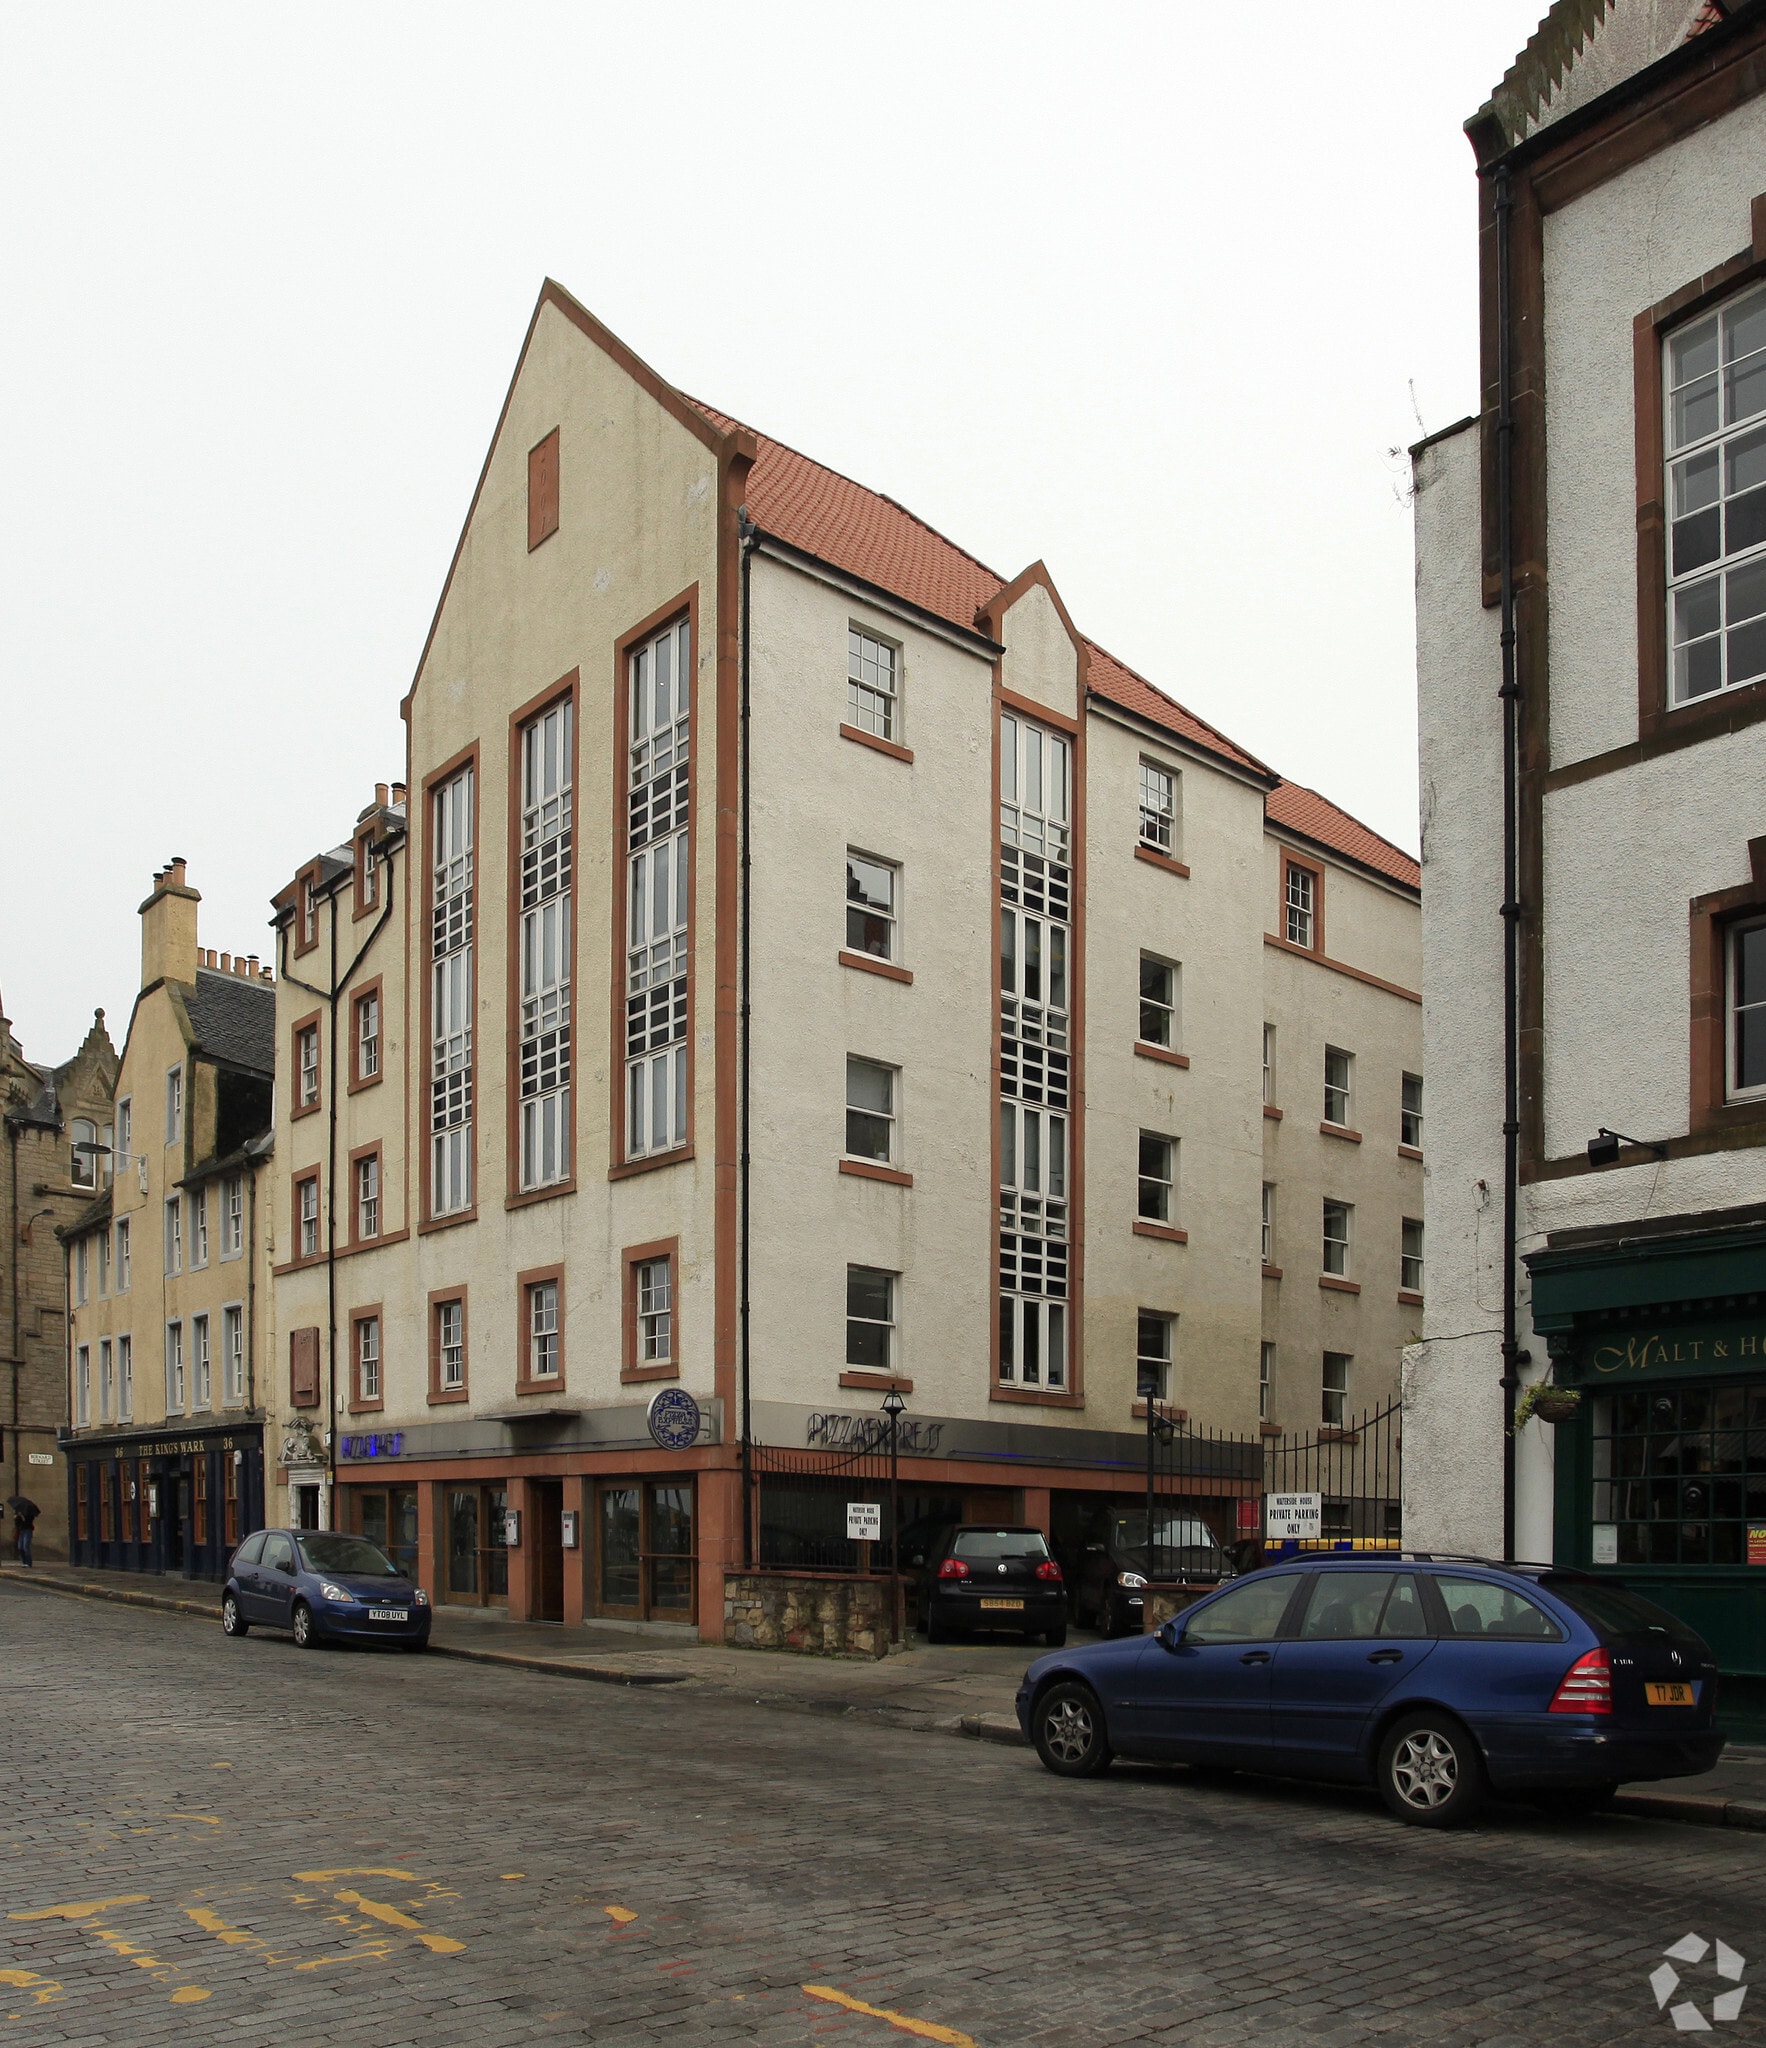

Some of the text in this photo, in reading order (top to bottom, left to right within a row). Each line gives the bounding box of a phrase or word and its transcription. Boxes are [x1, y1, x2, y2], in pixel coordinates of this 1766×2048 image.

[1713, 1339, 1729, 1358] &
[1740, 1335, 1766, 1356] H
[138, 1445, 153, 1457] THE
[155, 1442, 178, 1456] KING'S
[180, 1440, 205, 1453] WARK
[223, 1437, 233, 1450] 36
[1300, 1496, 1313, 1505] HOUSE
[1270, 1508, 1319, 1520] PRIVATE PARKING
[1286, 1523, 1301, 1534] ONLY
[1654, 1684, 1667, 1702] T7
